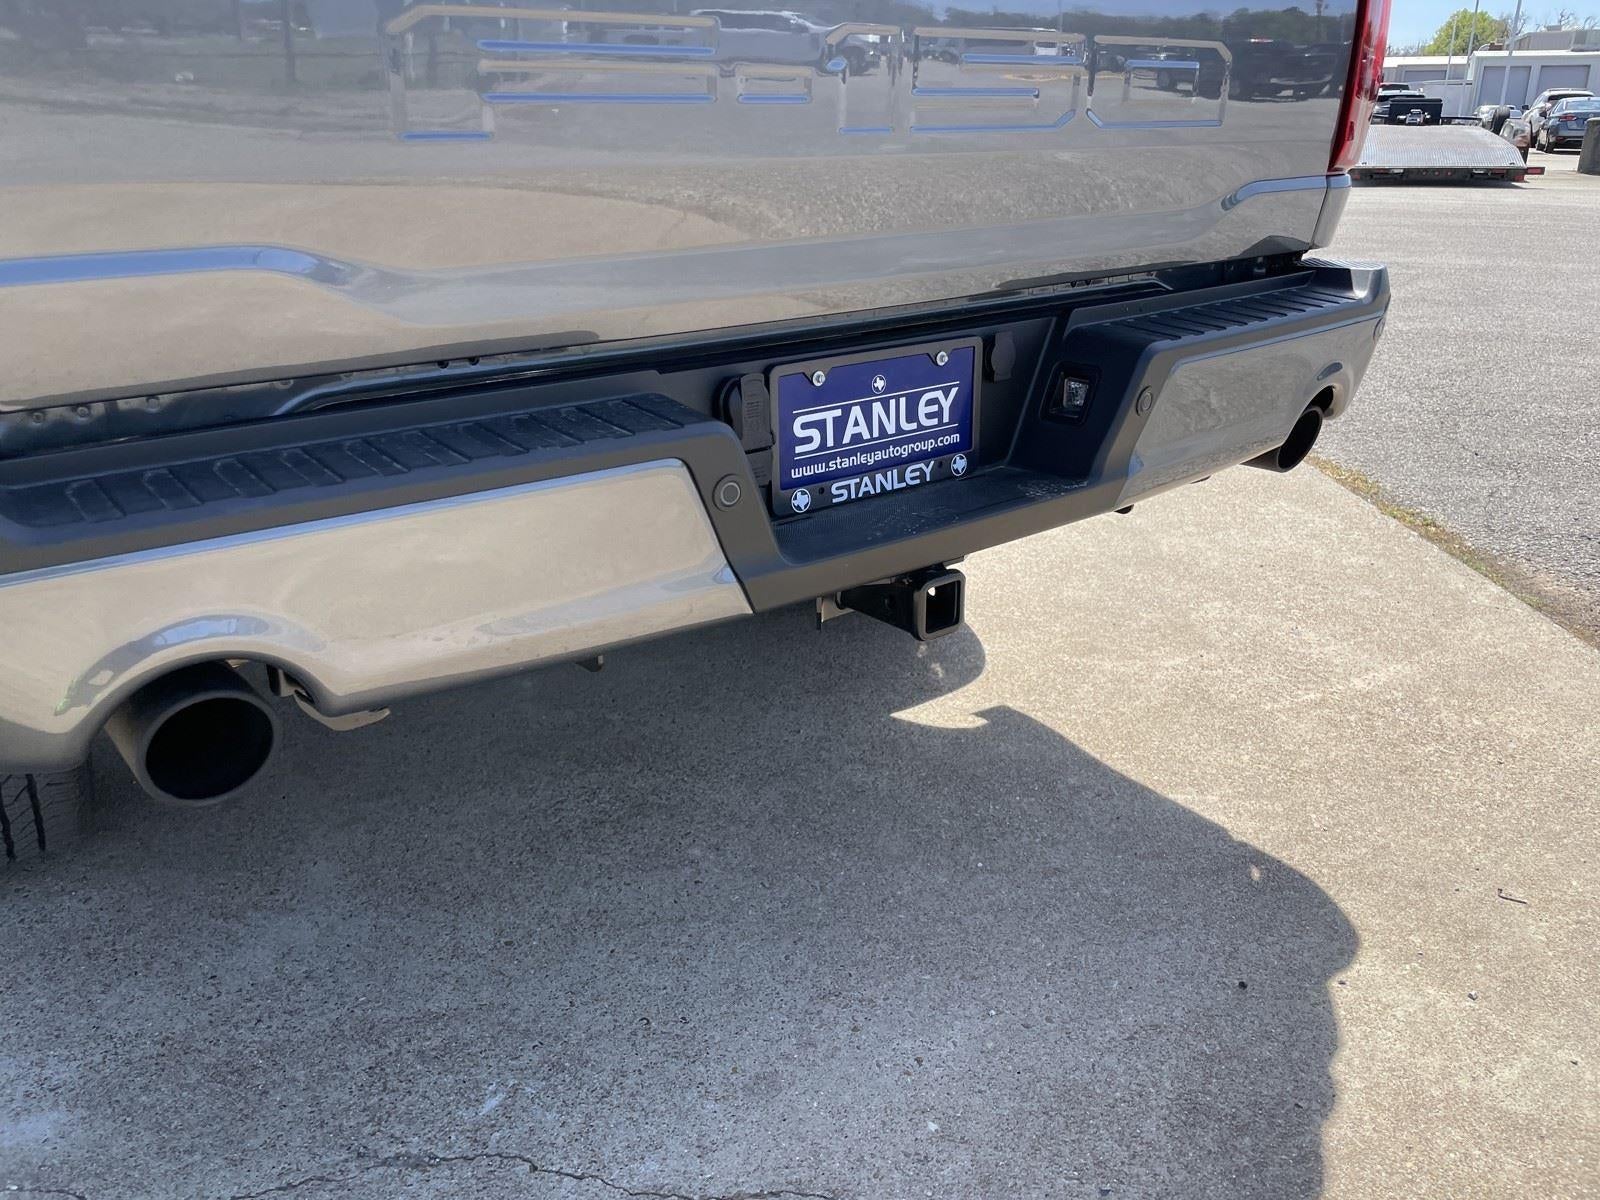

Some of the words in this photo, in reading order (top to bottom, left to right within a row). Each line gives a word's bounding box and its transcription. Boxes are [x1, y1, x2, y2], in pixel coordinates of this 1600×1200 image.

[384, 4, 1232, 141] F-150
[792, 387, 959, 454] STANLEY
[791, 433, 960, 479] www.stanleyautogroup.com
[832, 461, 935, 503] STANLEY
